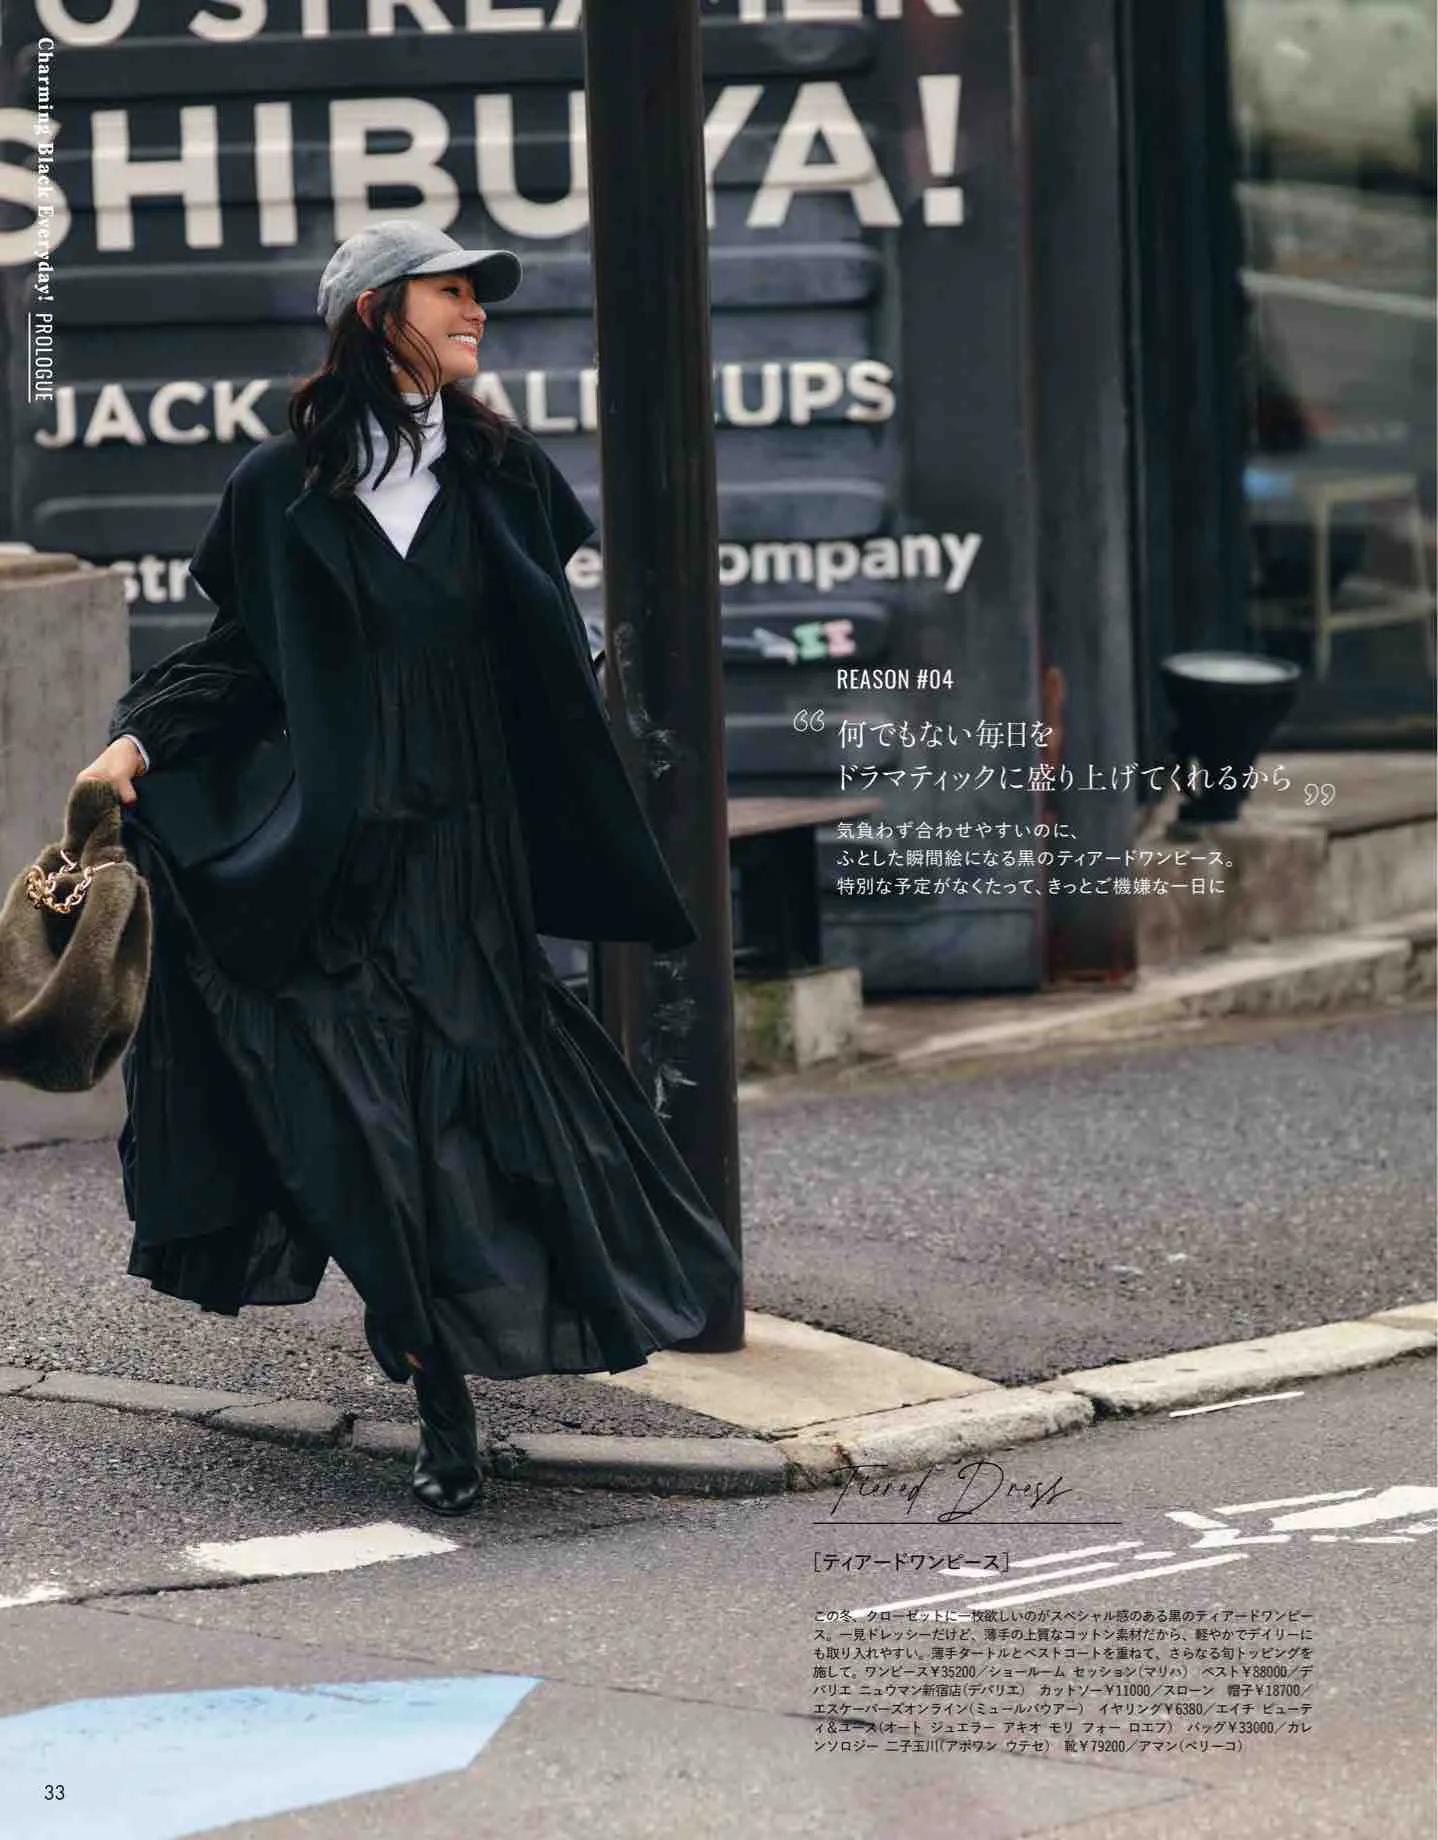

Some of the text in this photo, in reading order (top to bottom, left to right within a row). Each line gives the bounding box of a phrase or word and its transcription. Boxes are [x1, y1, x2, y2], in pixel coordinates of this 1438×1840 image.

[34, 379, 271, 447] JACK
[714, 360, 896, 427] UPS
[719, 532, 982, 593] ompany
